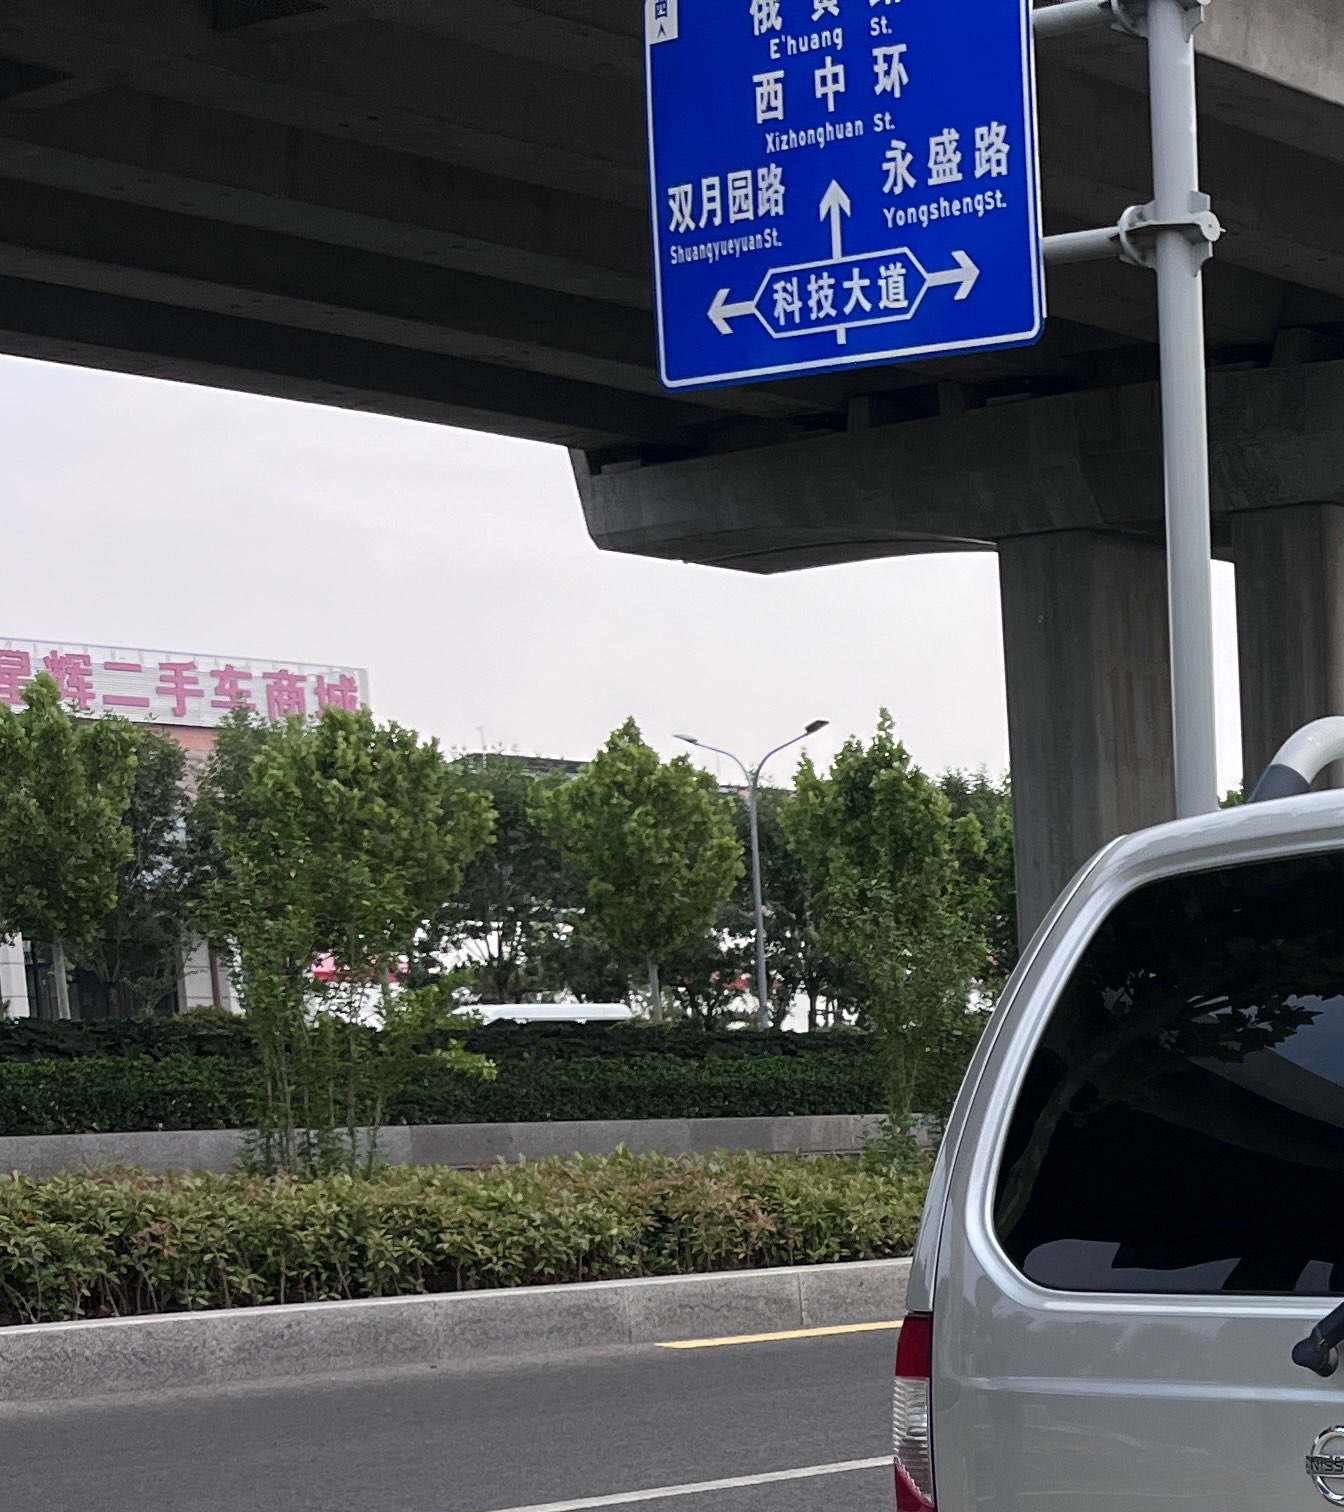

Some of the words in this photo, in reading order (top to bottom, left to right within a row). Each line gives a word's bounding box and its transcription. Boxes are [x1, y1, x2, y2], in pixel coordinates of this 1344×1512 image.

[769, 27, 843, 59] E'huang
[869, 16, 893, 36] St.
[752, 44, 909, 124] 西中环
[765, 119, 864, 154] Xizhonghuan
[872, 112, 896, 132] St.
[881, 121, 1010, 195] 永盛路
[667, 162, 785, 233] 双月园路
[772, 262, 909, 326] 科技大道
